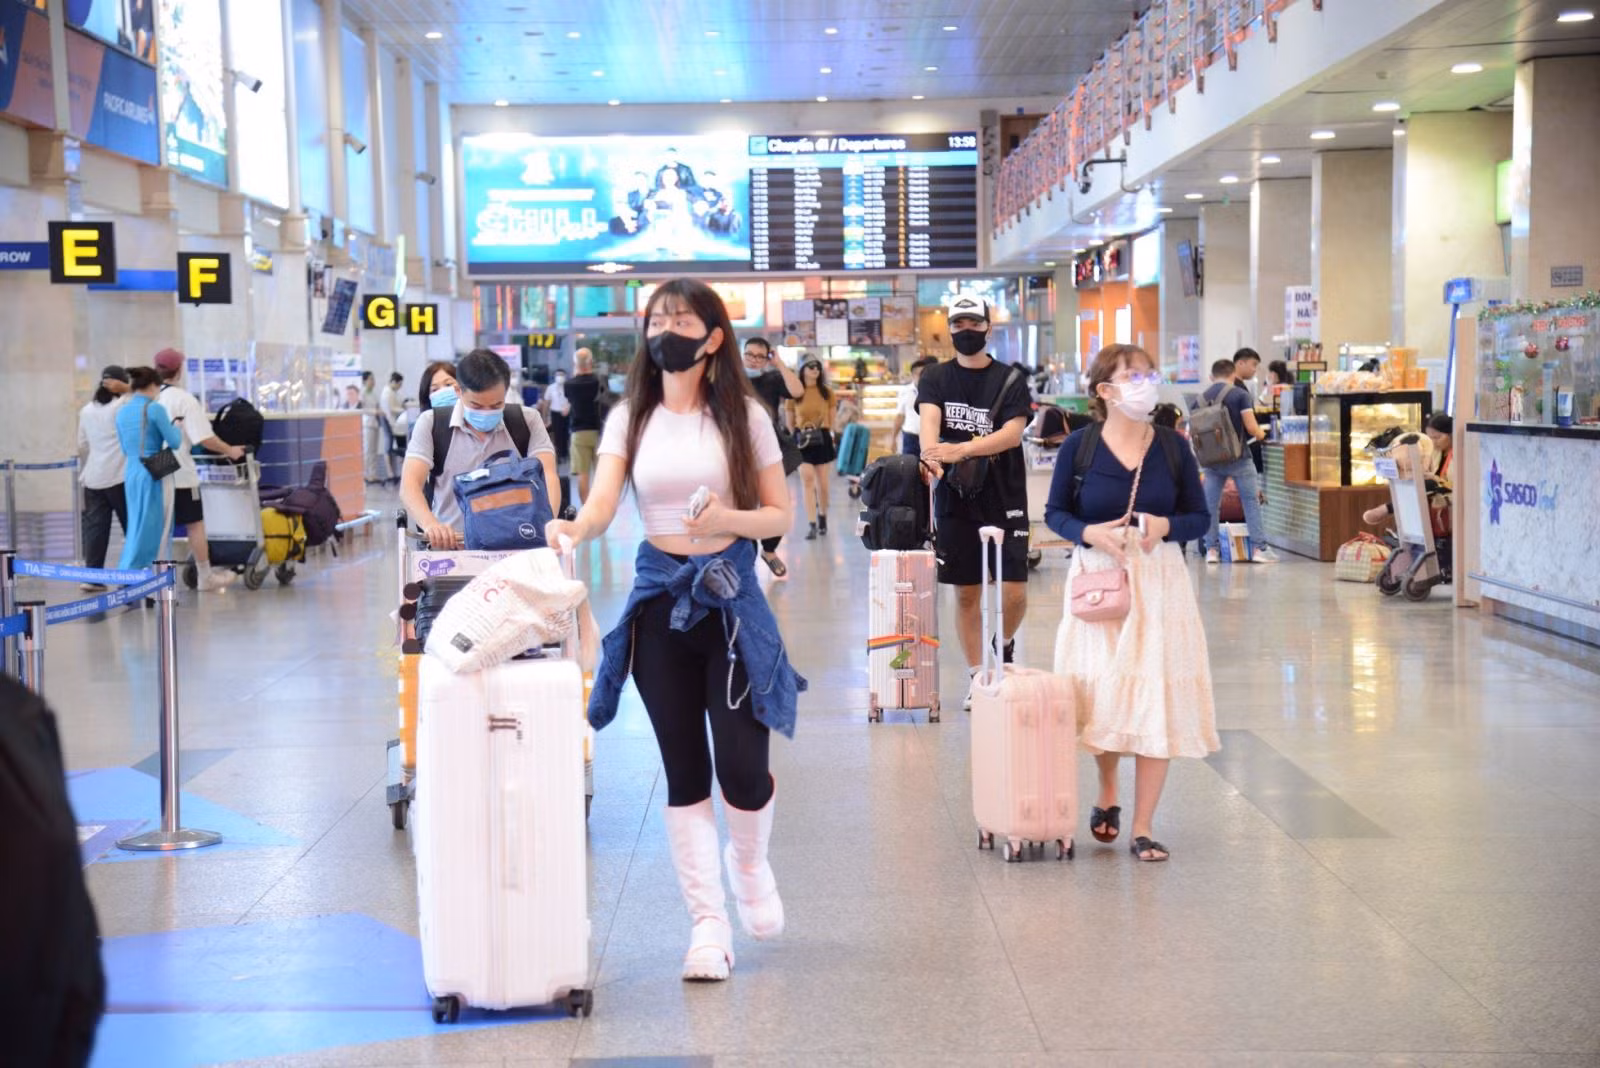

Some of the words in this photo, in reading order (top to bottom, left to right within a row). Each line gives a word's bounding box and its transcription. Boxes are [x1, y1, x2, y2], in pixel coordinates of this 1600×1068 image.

[838, 137, 906, 153] Departures
[0, 251, 32, 263] ROW
[62, 229, 102, 276] E
[188, 258, 219, 298] F
[367, 297, 395, 327] G
[411, 306, 433, 333] H
[946, 406, 966, 420] KEEP
[1504, 482, 1537, 508] SASCO
[24, 563, 40, 575] TIA
